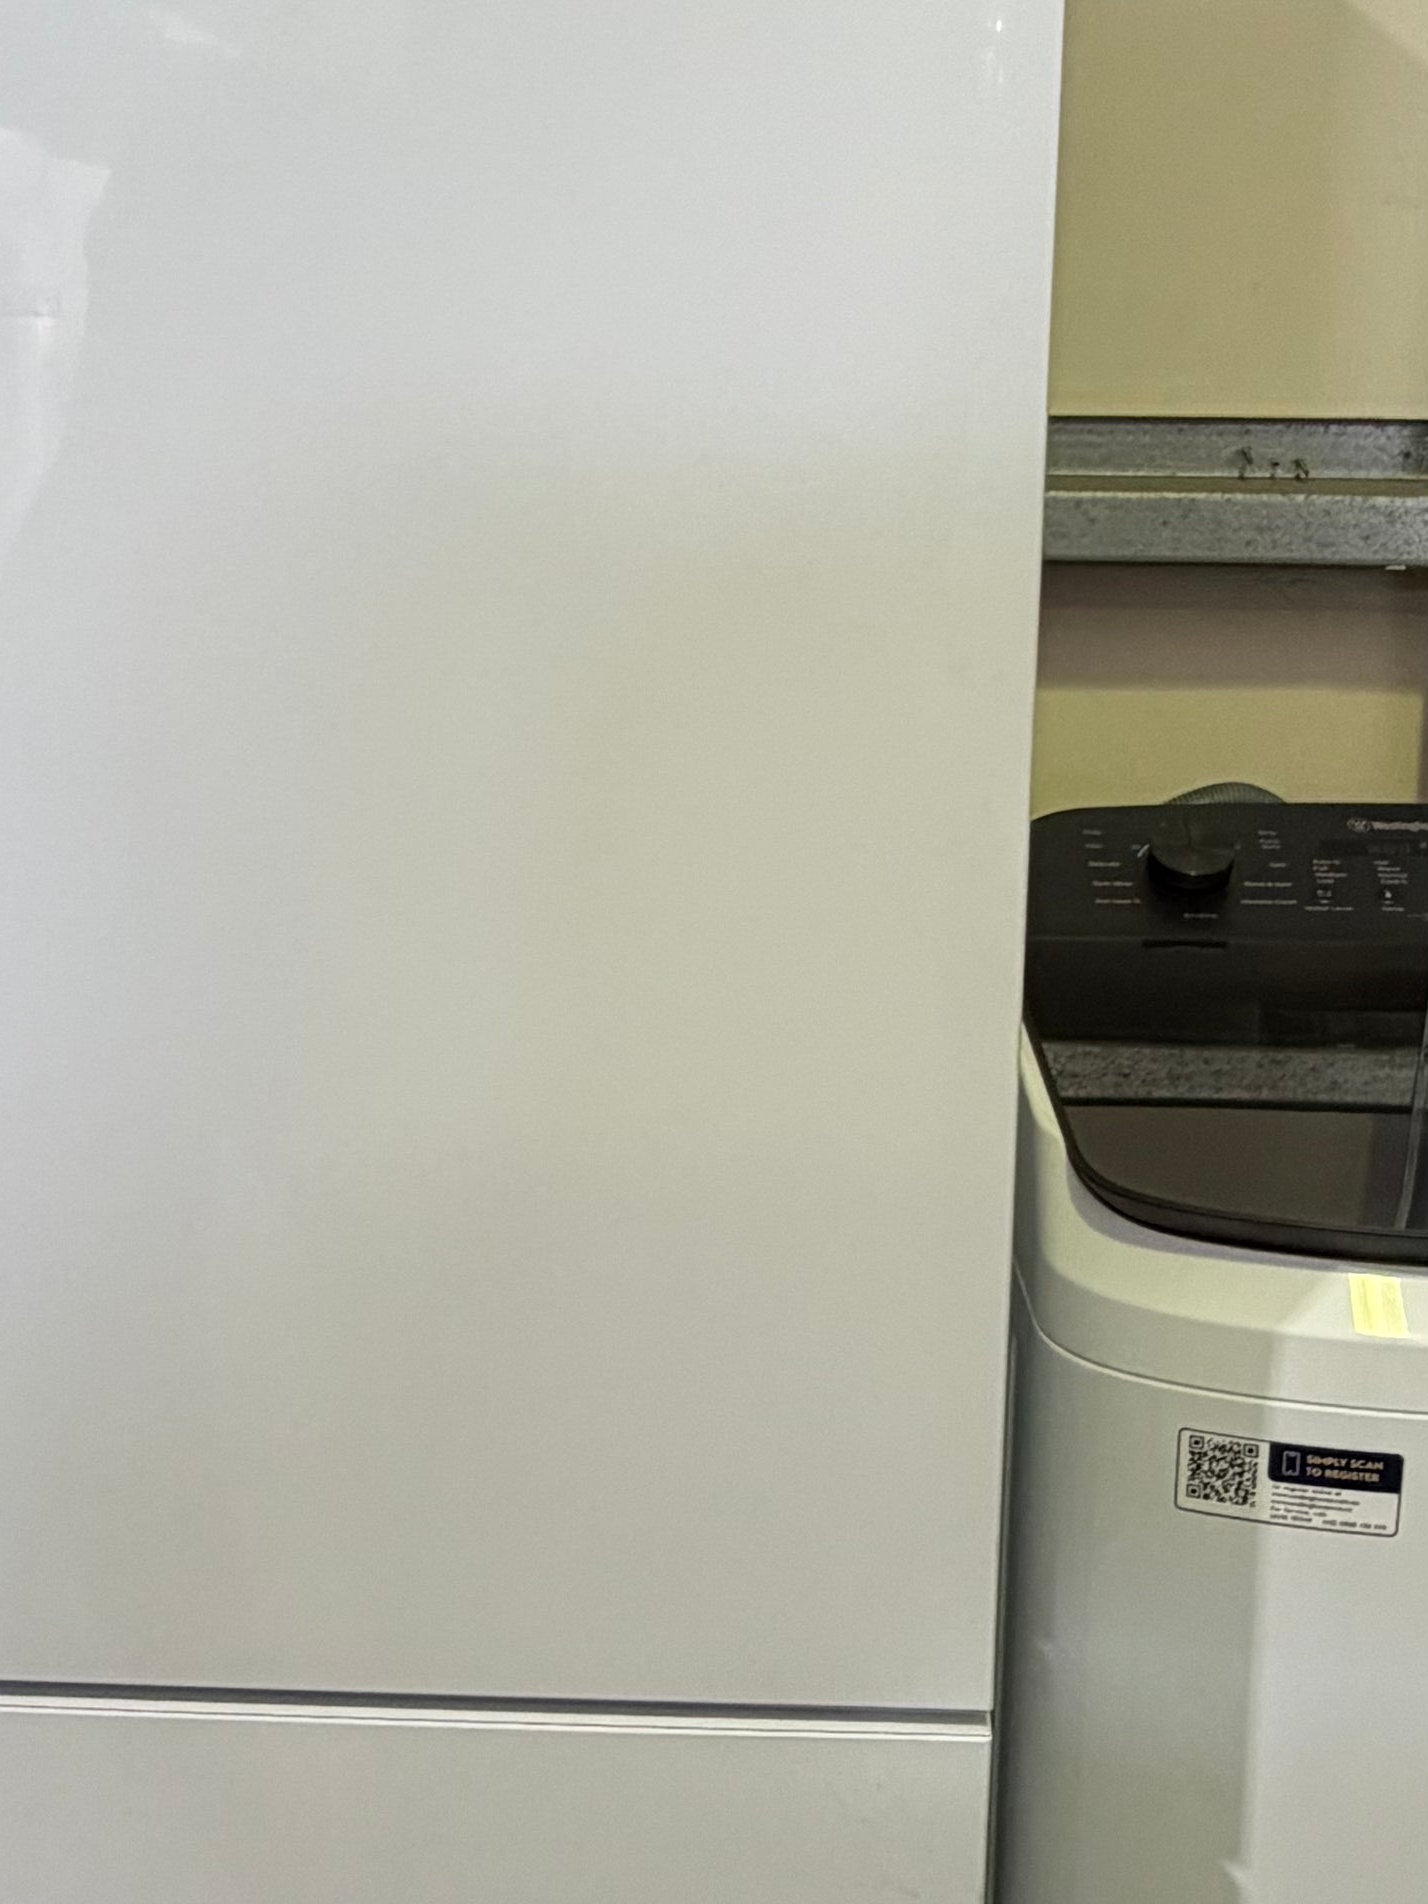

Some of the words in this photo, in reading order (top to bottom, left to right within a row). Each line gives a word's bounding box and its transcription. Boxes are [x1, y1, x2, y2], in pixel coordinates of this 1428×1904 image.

[1350, 1458, 1384, 1471] SCAN
[1305, 1467, 1322, 1478] TO
[1324, 1468, 1380, 1483] REGISTER
